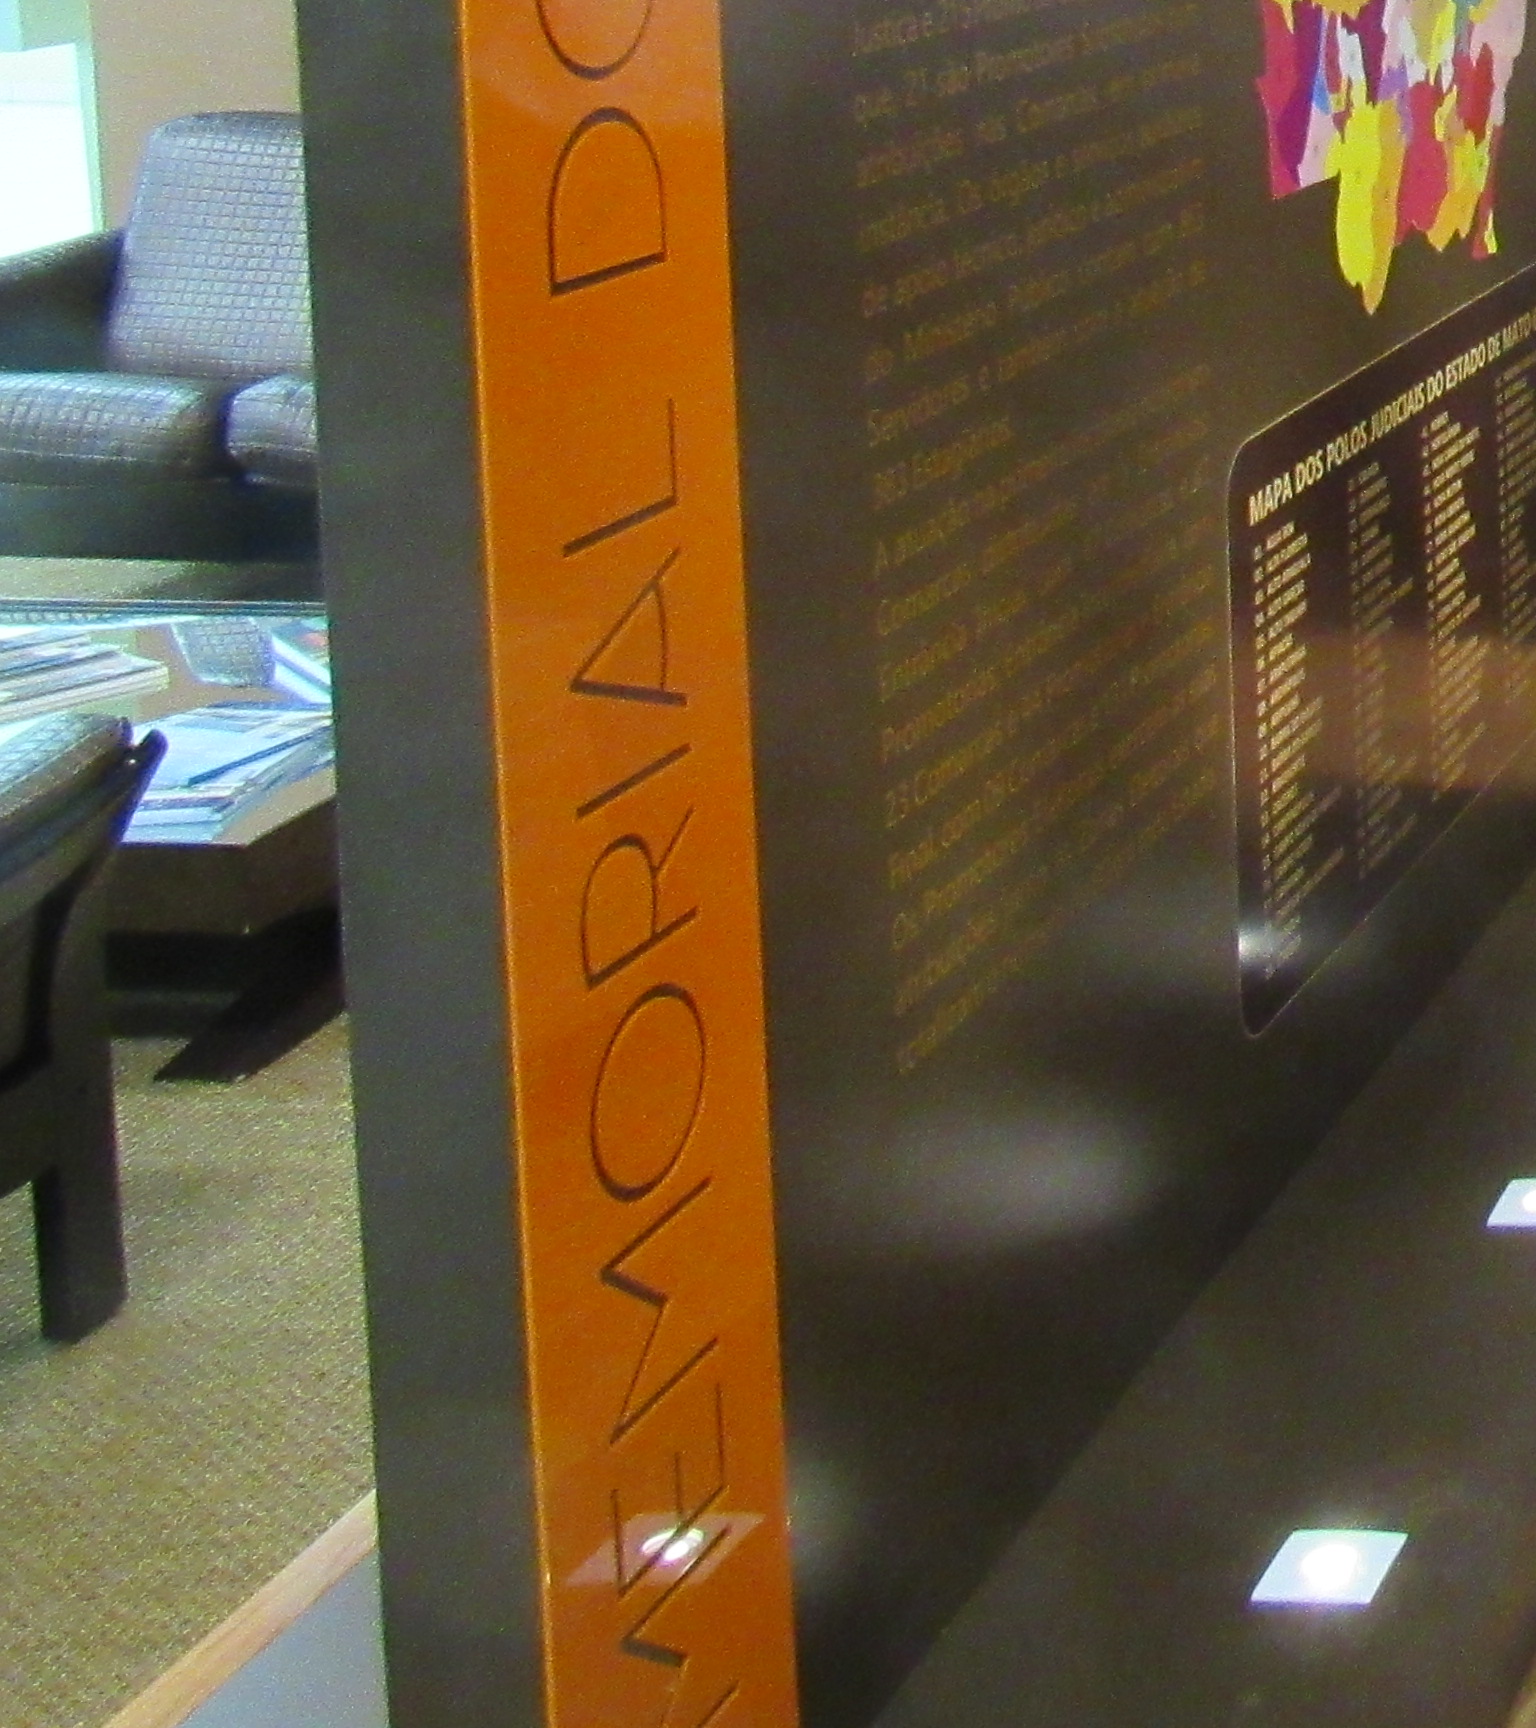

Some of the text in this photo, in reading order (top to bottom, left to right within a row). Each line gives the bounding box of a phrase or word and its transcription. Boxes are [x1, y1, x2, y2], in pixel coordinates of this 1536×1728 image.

[1250, 472, 1293, 527] MAPA
[1295, 448, 1324, 494] DOS
[1326, 420, 1368, 472] POLOS
[1370, 380, 1426, 443] JUDICIAIS
[1427, 369, 1444, 404] DO
[1445, 341, 1486, 391] ESTADO
[1486, 332, 1501, 363] DE
